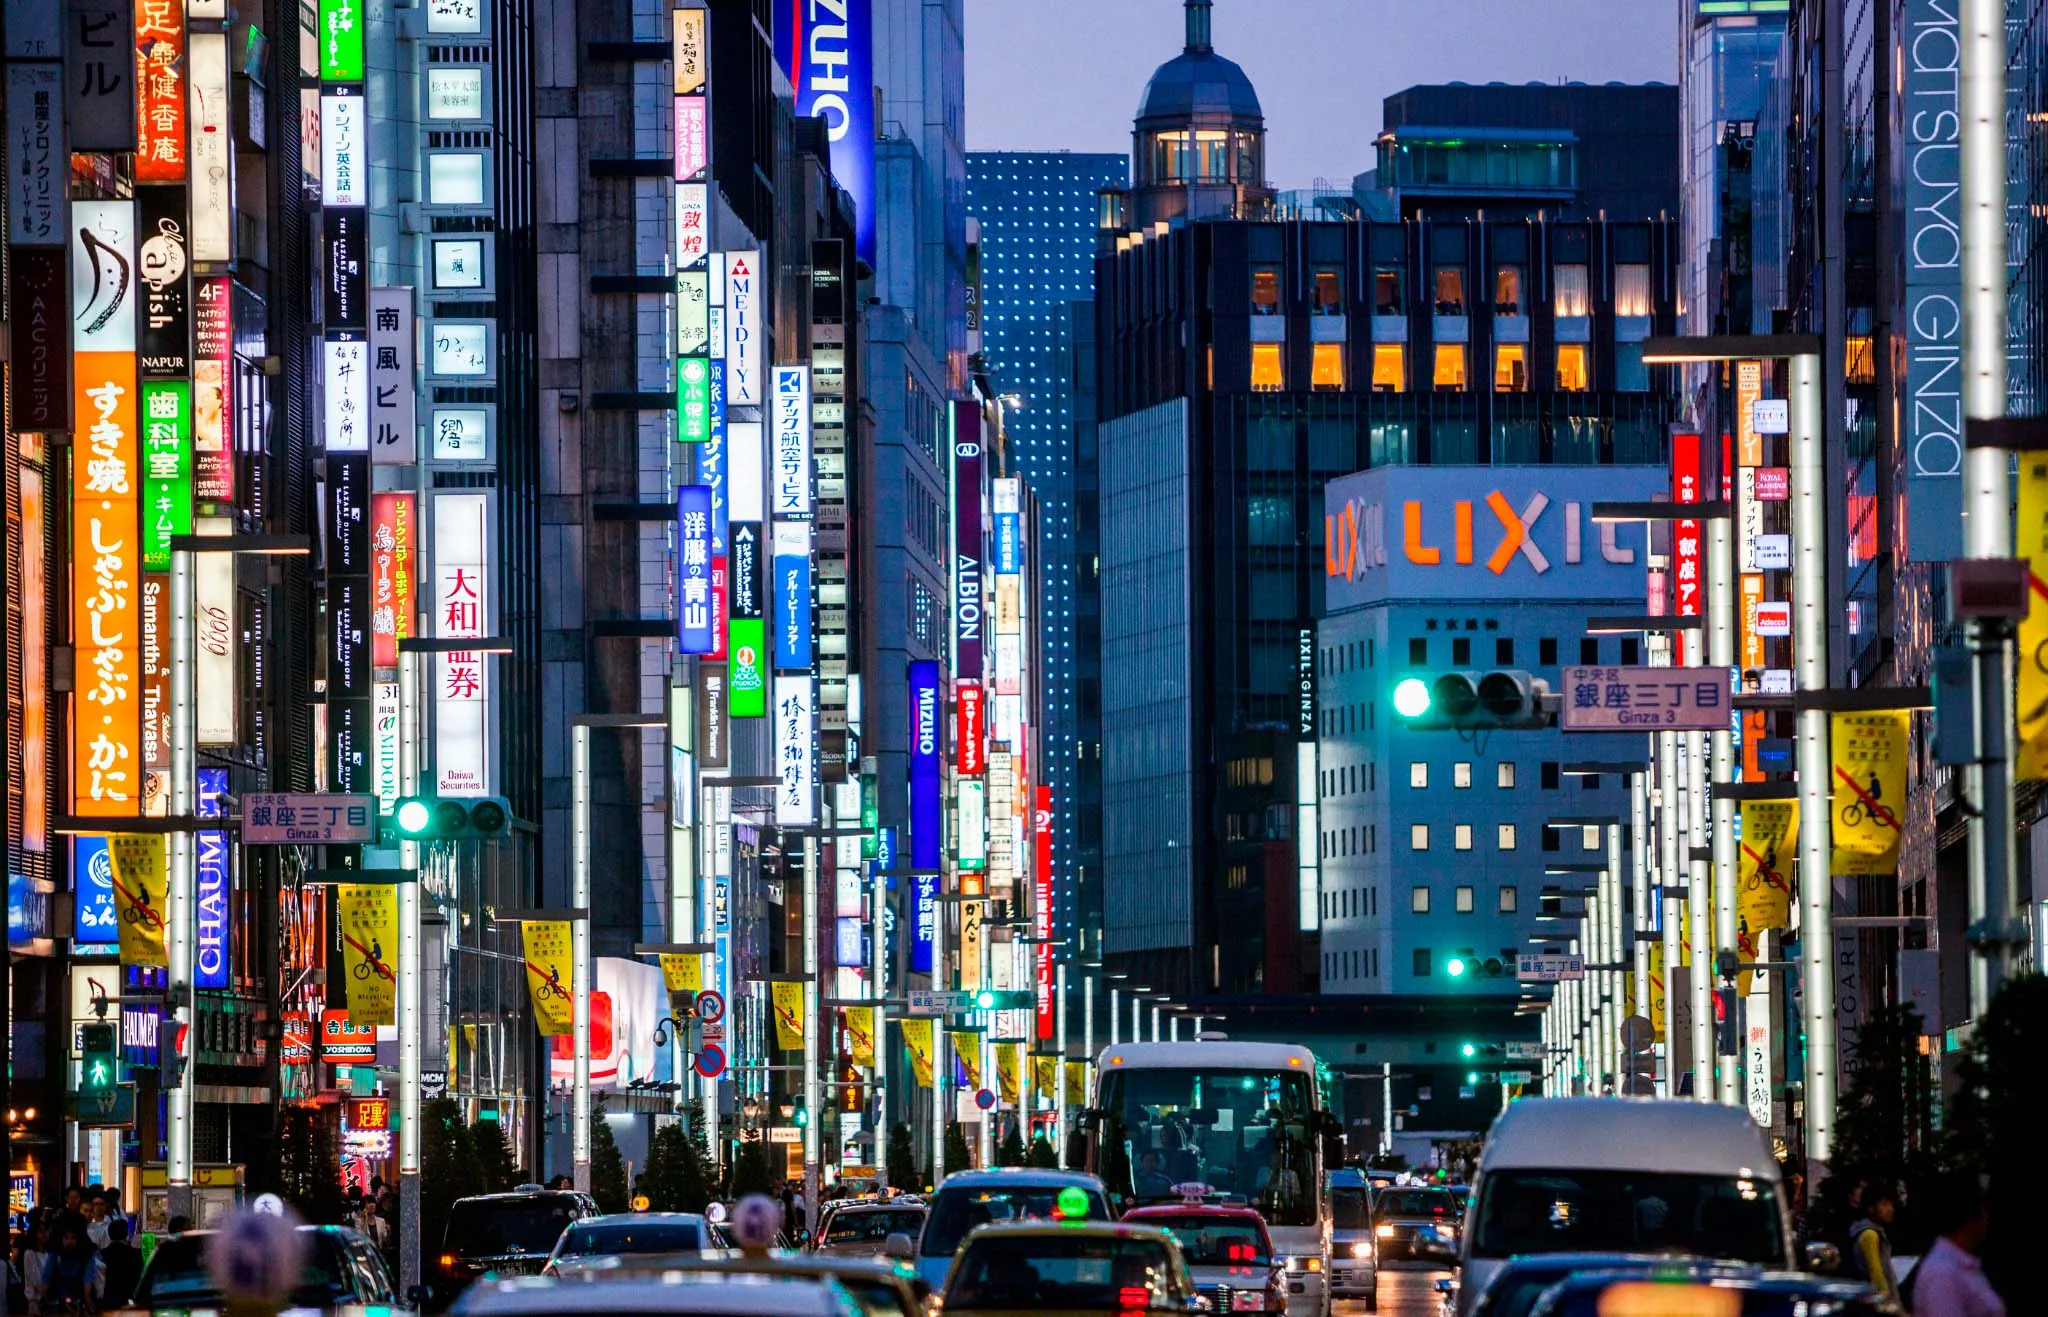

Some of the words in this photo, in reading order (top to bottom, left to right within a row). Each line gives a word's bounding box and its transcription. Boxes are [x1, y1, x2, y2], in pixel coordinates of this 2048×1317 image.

[80, 14, 120, 97] ビル
[682, 211, 702, 253] 敦煌
[141, 252, 174, 329] apish
[200, 284, 223, 301] 4F
[340, 275, 348, 319] DIAMOND
[32, 297, 49, 422] AACクリニック
[142, 357, 184, 368] NAPUR
[733, 279, 750, 400] MEIDIYA
[375, 307, 400, 446] 南風ビル
[439, 418, 464, 449] 響
[780, 396, 801, 507] テック航空サービス
[1326, 497, 1385, 583] LIXIL
[1404, 490, 1635, 575] LIXIL
[86, 382, 129, 801] すき焼・しゃぶしゃぶ・かに
[683, 511, 708, 629] 洋服の青山
[959, 555, 978, 639] ALBION
[144, 582, 161, 675] Samantha
[445, 569, 479, 698] 大和証券
[1573, 669, 1619, 681] 中央区
[1574, 683, 1720, 708] 銀座三丁目
[144, 684, 161, 762] Thavasa
[709, 691, 719, 726] Franklin
[920, 688, 935, 755] MIZUHO
[1618, 709, 1659, 723] Ginza
[1665, 710, 1675, 723] 3
[440, 780, 481, 790] Securities
[447, 770, 474, 780] Daiwa
[252, 806, 367, 826] 銀座三丁目
[286, 828, 319, 839] Ginza
[323, 829, 332, 839] 3
[719, 825, 728, 854] ELITE
[199, 782, 221, 975] CHAUMT
[1520, 960, 1581, 973] 銀座二丁目
[1841, 935, 1858, 1075] BVLGARI
[326, 1045, 372, 1054] YOSHINOYA
[421, 1073, 443, 1083] MCM
